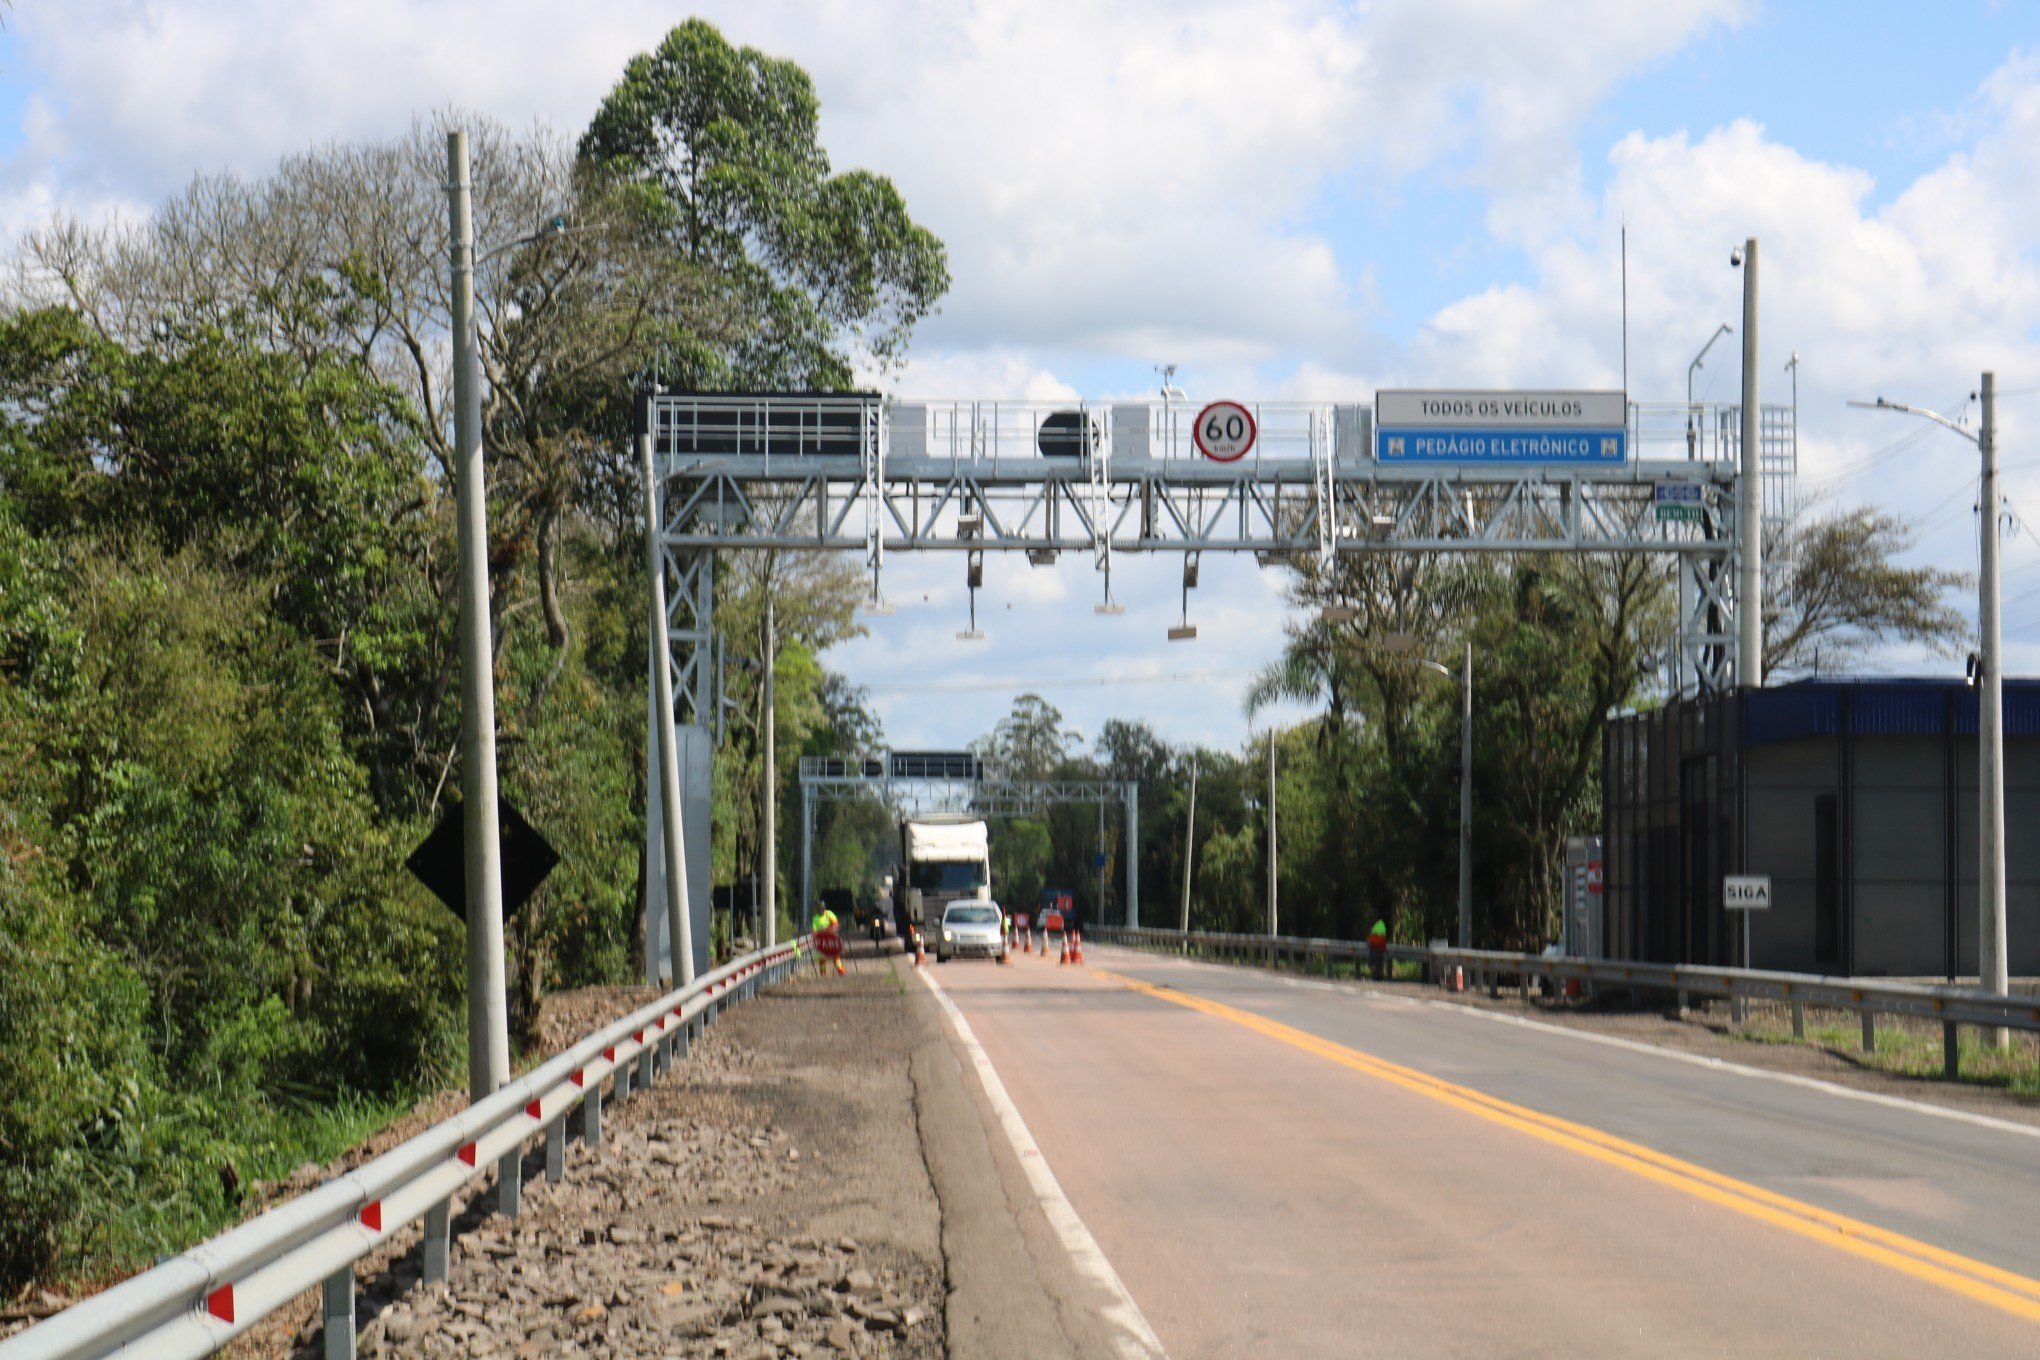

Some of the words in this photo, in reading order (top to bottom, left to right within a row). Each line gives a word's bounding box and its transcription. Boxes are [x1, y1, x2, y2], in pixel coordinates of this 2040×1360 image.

[1421, 400, 1473, 416] TODOS
[1479, 400, 1498, 416] OS
[1503, 396, 1583, 417] VEÍCULOS
[1205, 414, 1244, 442] 60
[1416, 434, 1486, 456] PEDÁGIO
[1491, 434, 1590, 456] ELETRÔNICO
[1727, 884, 1767, 901] SIGA
